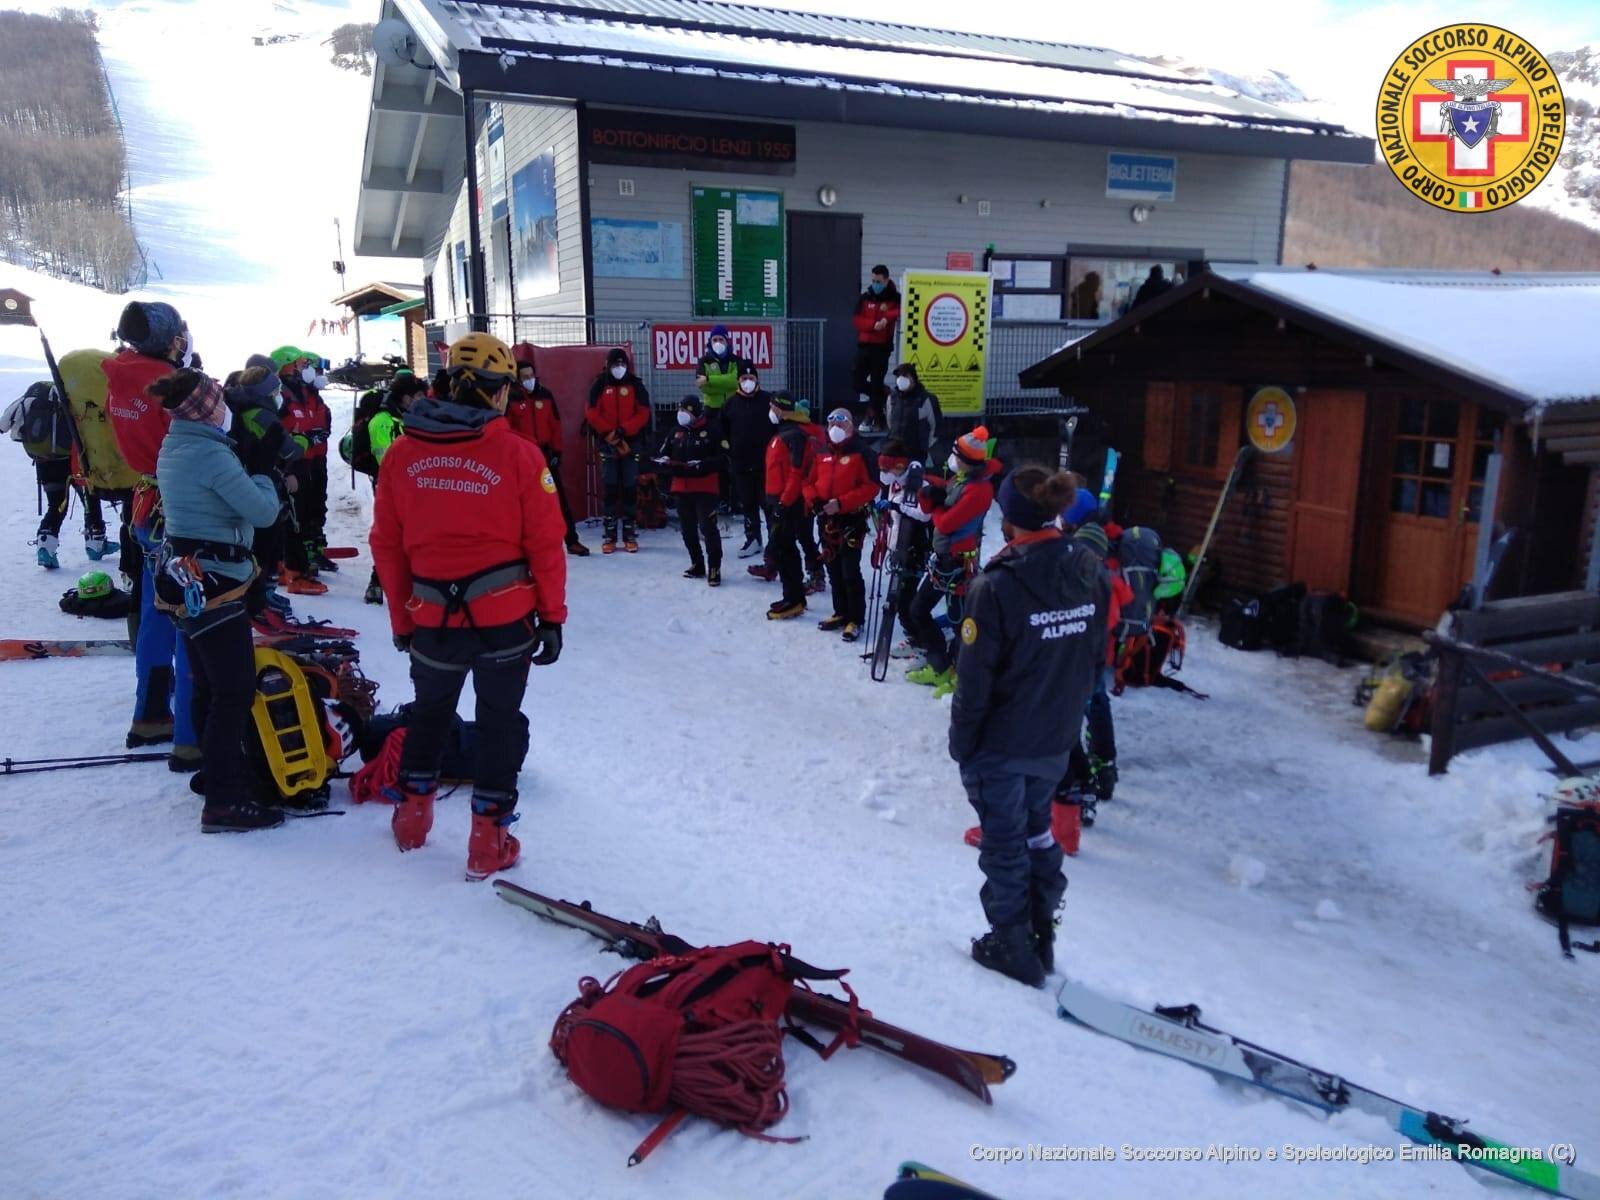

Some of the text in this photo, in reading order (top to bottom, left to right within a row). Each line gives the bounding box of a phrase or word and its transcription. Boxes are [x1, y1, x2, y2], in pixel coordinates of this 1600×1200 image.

[593, 128, 791, 159] BOTTONIFICIO LENZI 1955
[655, 330, 770, 365] BIGLIEERIA
[407, 457, 501, 486] SOCCORSO ALPINO
[417, 477, 488, 495] SPELEOLOGICO
[1030, 603, 1095, 626] SOCCORSO
[1041, 621, 1086, 639] ALPINO
[1139, 1024, 1218, 1057] MAJESTY
